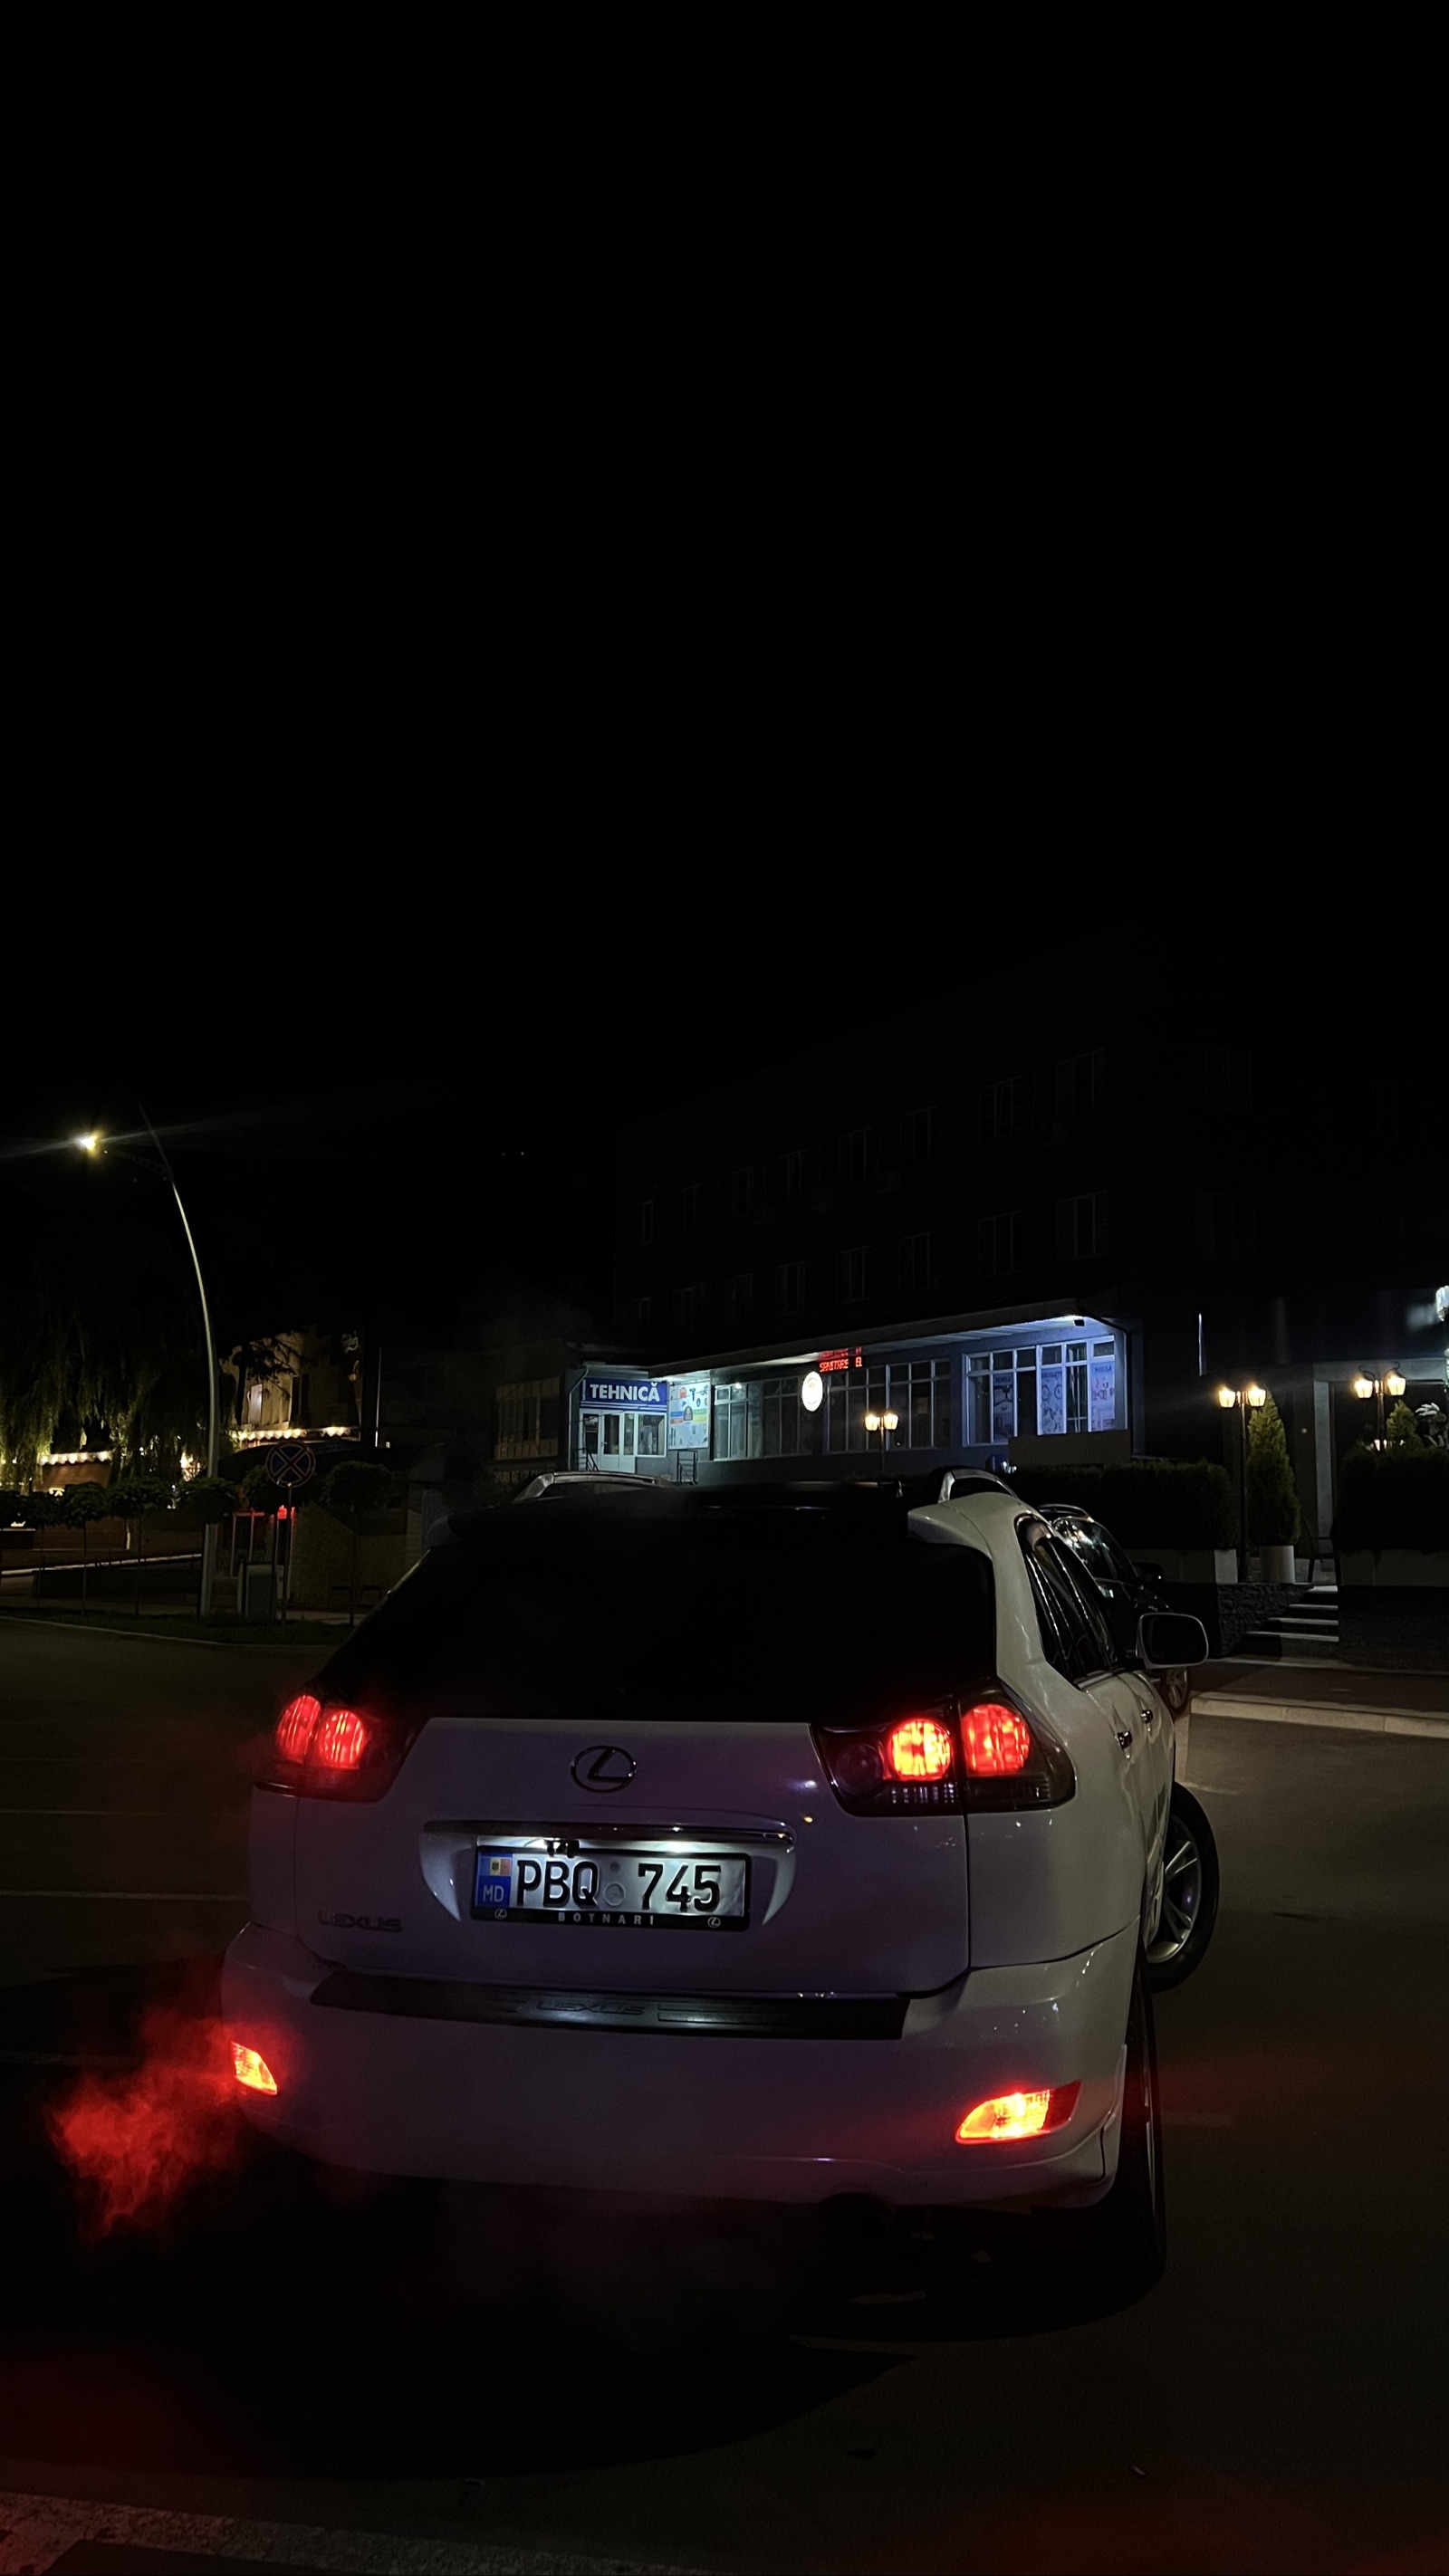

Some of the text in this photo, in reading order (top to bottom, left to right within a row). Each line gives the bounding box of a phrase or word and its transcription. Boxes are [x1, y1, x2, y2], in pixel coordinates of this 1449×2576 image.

[590, 1382, 660, 1402] TEHNICĂ
[483, 1884, 504, 1902] MD
[516, 1859, 722, 1912] PBQ 745
[317, 1910, 403, 1933] LEXUS
[558, 1912, 655, 1926] BOTNARI
[536, 2001, 646, 2016] LEXUS
